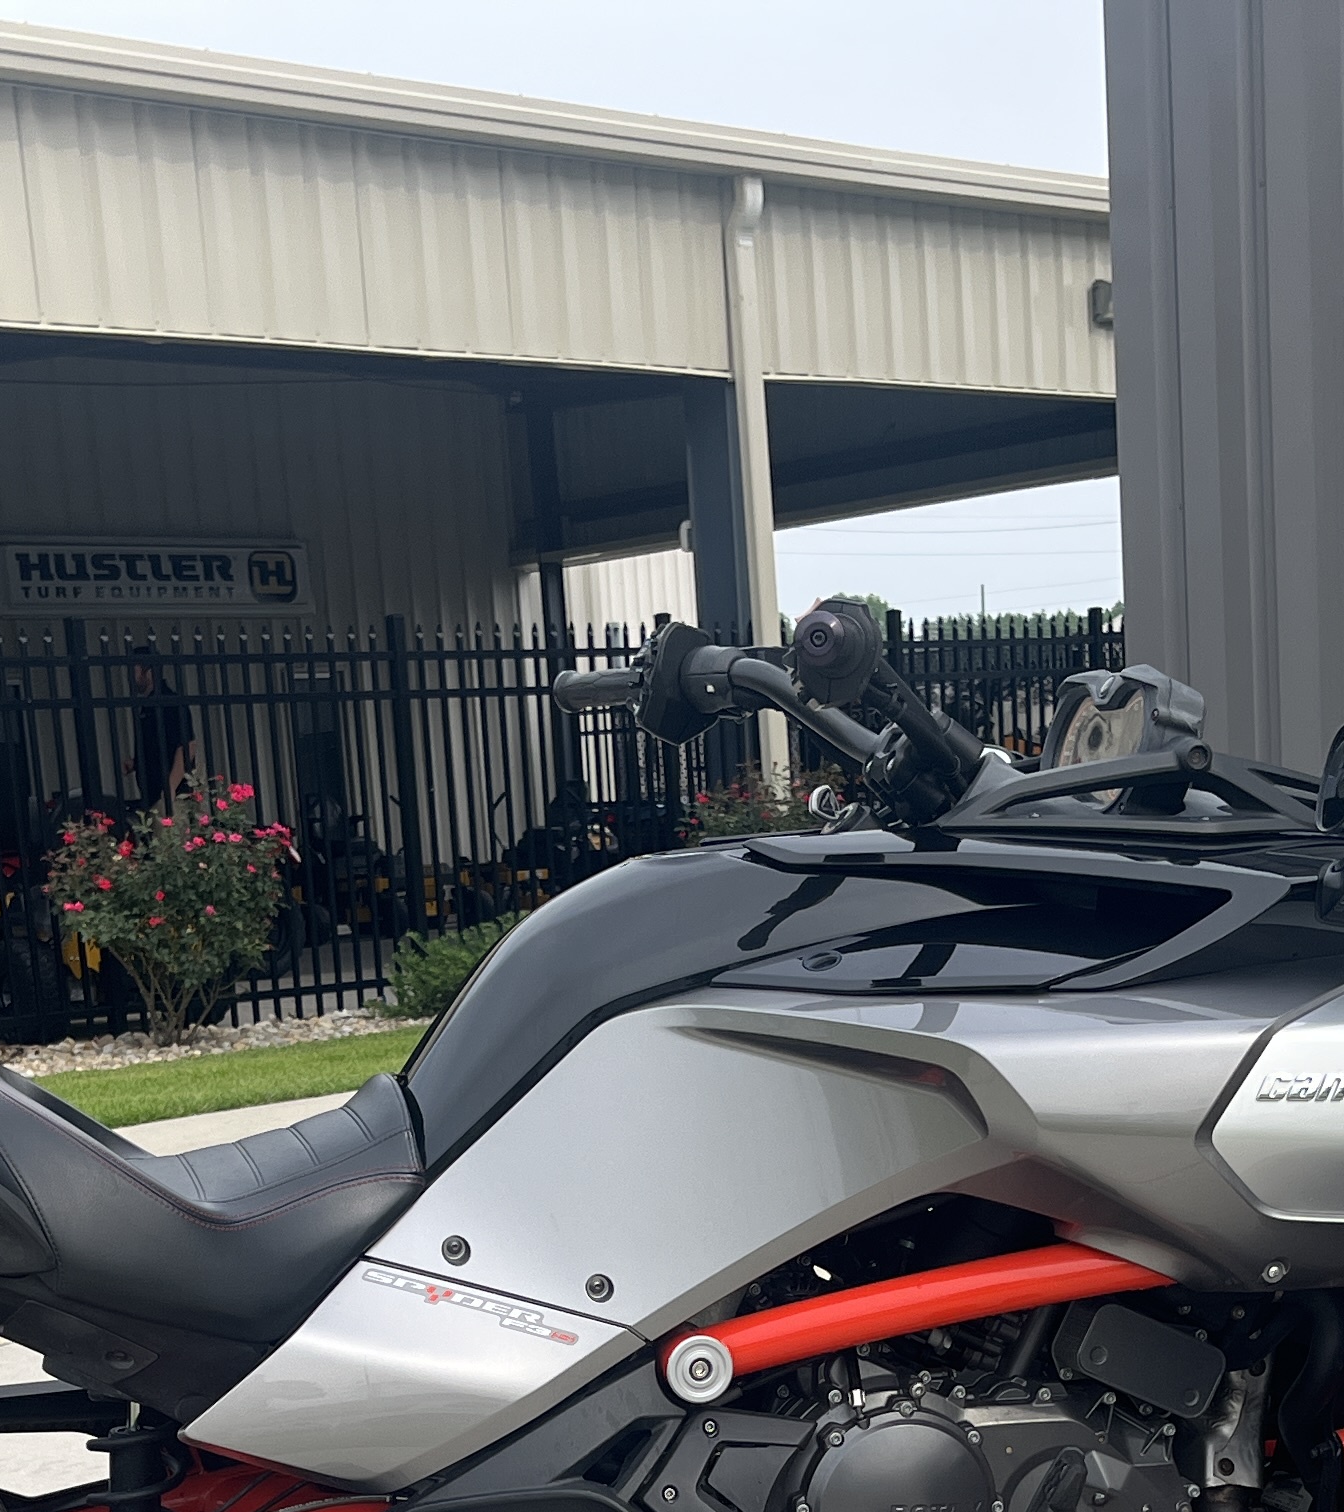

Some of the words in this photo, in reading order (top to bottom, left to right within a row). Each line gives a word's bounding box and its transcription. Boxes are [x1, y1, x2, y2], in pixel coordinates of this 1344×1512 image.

[14, 553, 236, 583] HUSTLER
[20, 585, 83, 599] TURF
[94, 585, 236, 600] EQUIPMENT
